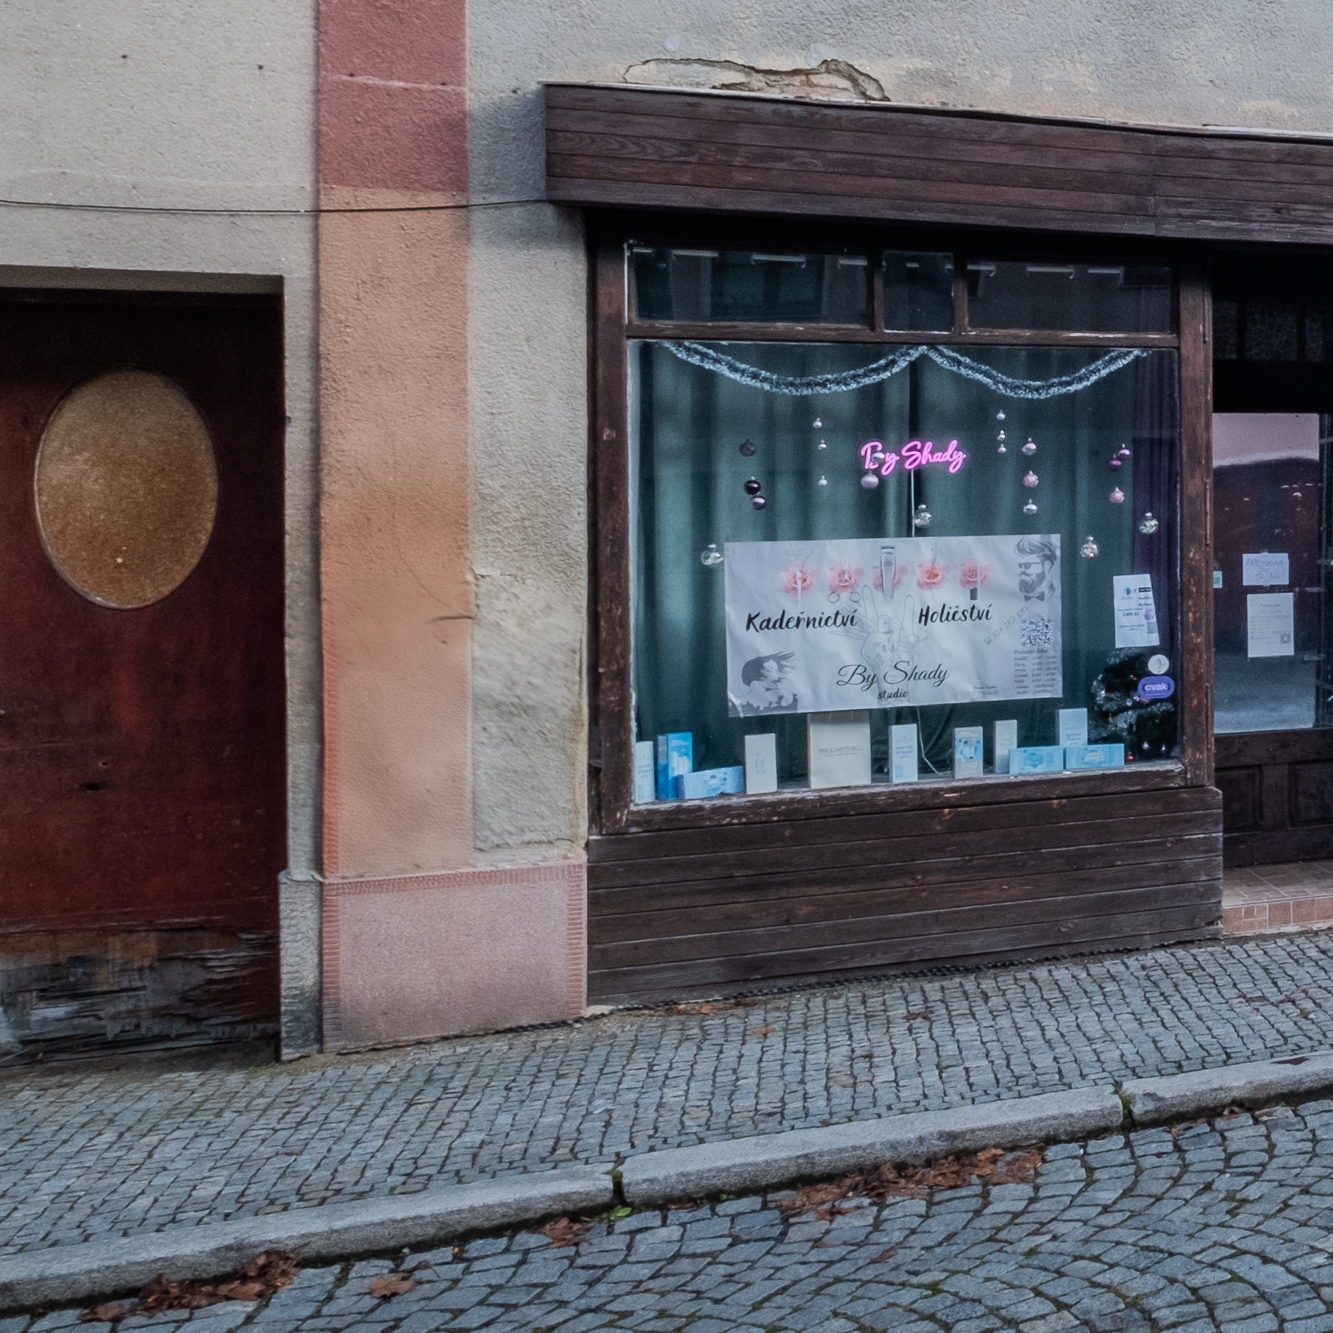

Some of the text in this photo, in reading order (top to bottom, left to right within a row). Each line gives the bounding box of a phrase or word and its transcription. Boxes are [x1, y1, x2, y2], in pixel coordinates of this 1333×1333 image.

[860, 439, 967, 476] By Shady
[745, 608, 859, 633] Kadeřnictví
[918, 603, 994, 626] Holičství
[835, 663, 879, 692] By
[883, 660, 950, 690] Shady
[1144, 682, 1168, 691] cvak
[878, 688, 908, 700] studio
